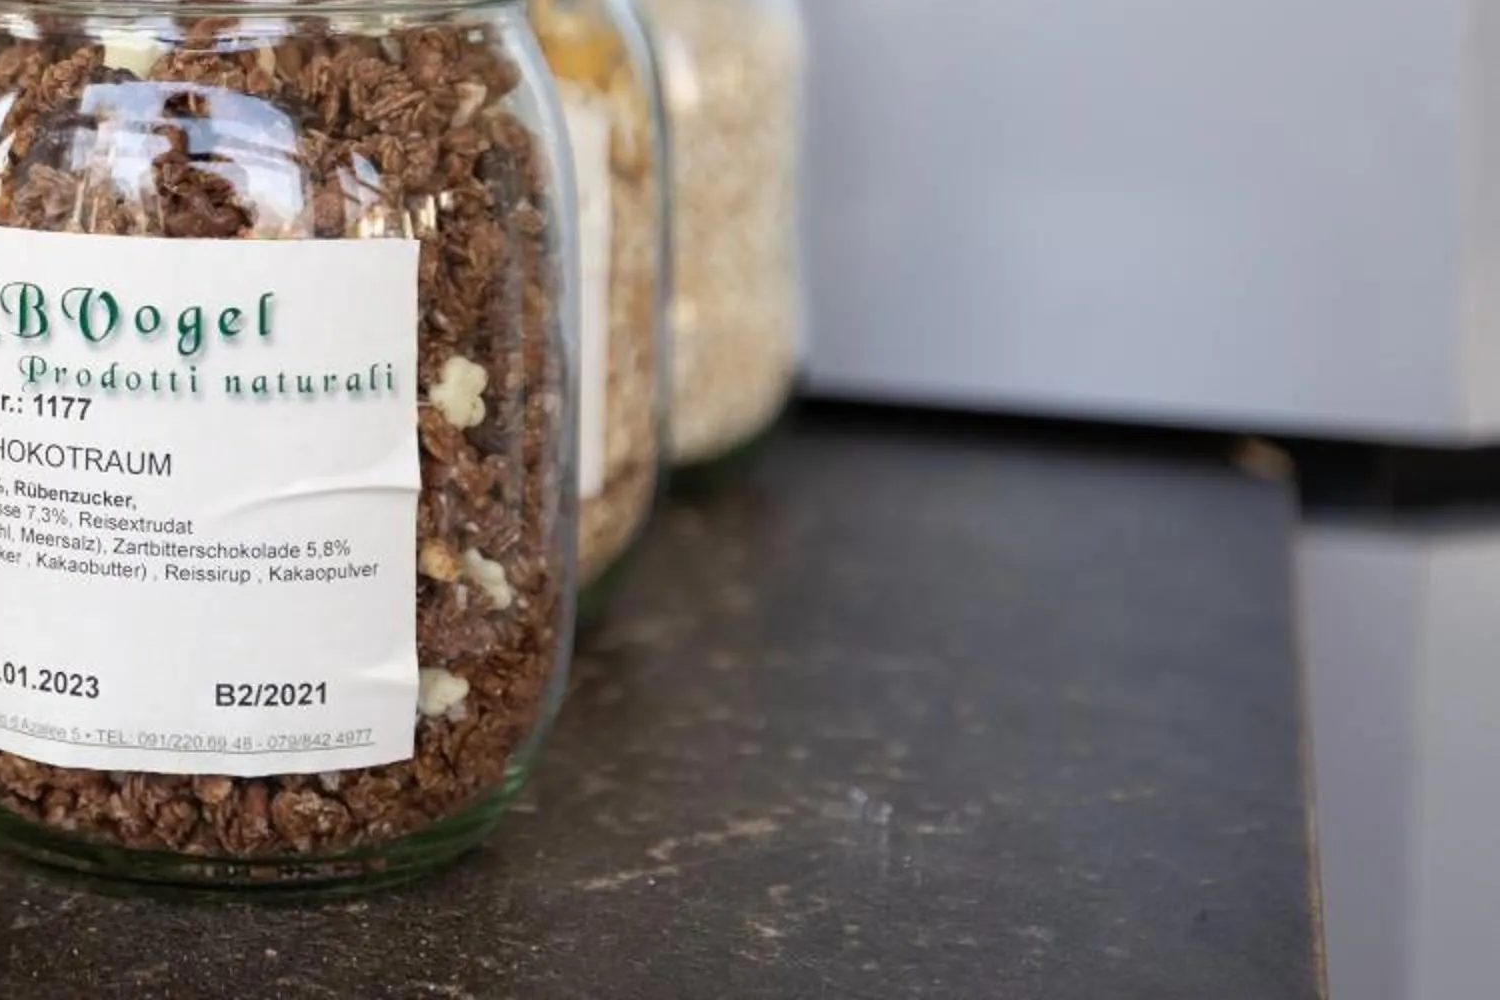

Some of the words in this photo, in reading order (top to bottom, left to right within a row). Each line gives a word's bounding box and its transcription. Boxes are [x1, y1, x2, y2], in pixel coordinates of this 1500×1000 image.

[19, 355, 198, 393] Prodotti
[224, 362, 394, 394] naturali
[33, 393, 93, 421] 1177
[14, 479, 137, 511] Rübenzucker,
[79, 511, 194, 535] Reisextrudat
[112, 537, 301, 560] Zartbitterschokolade
[306, 539, 351, 558] 5,8%
[165, 563, 251, 584] Reissirup
[269, 563, 379, 583] Kakaopulver
[215, 682, 328, 707] B2/2021
